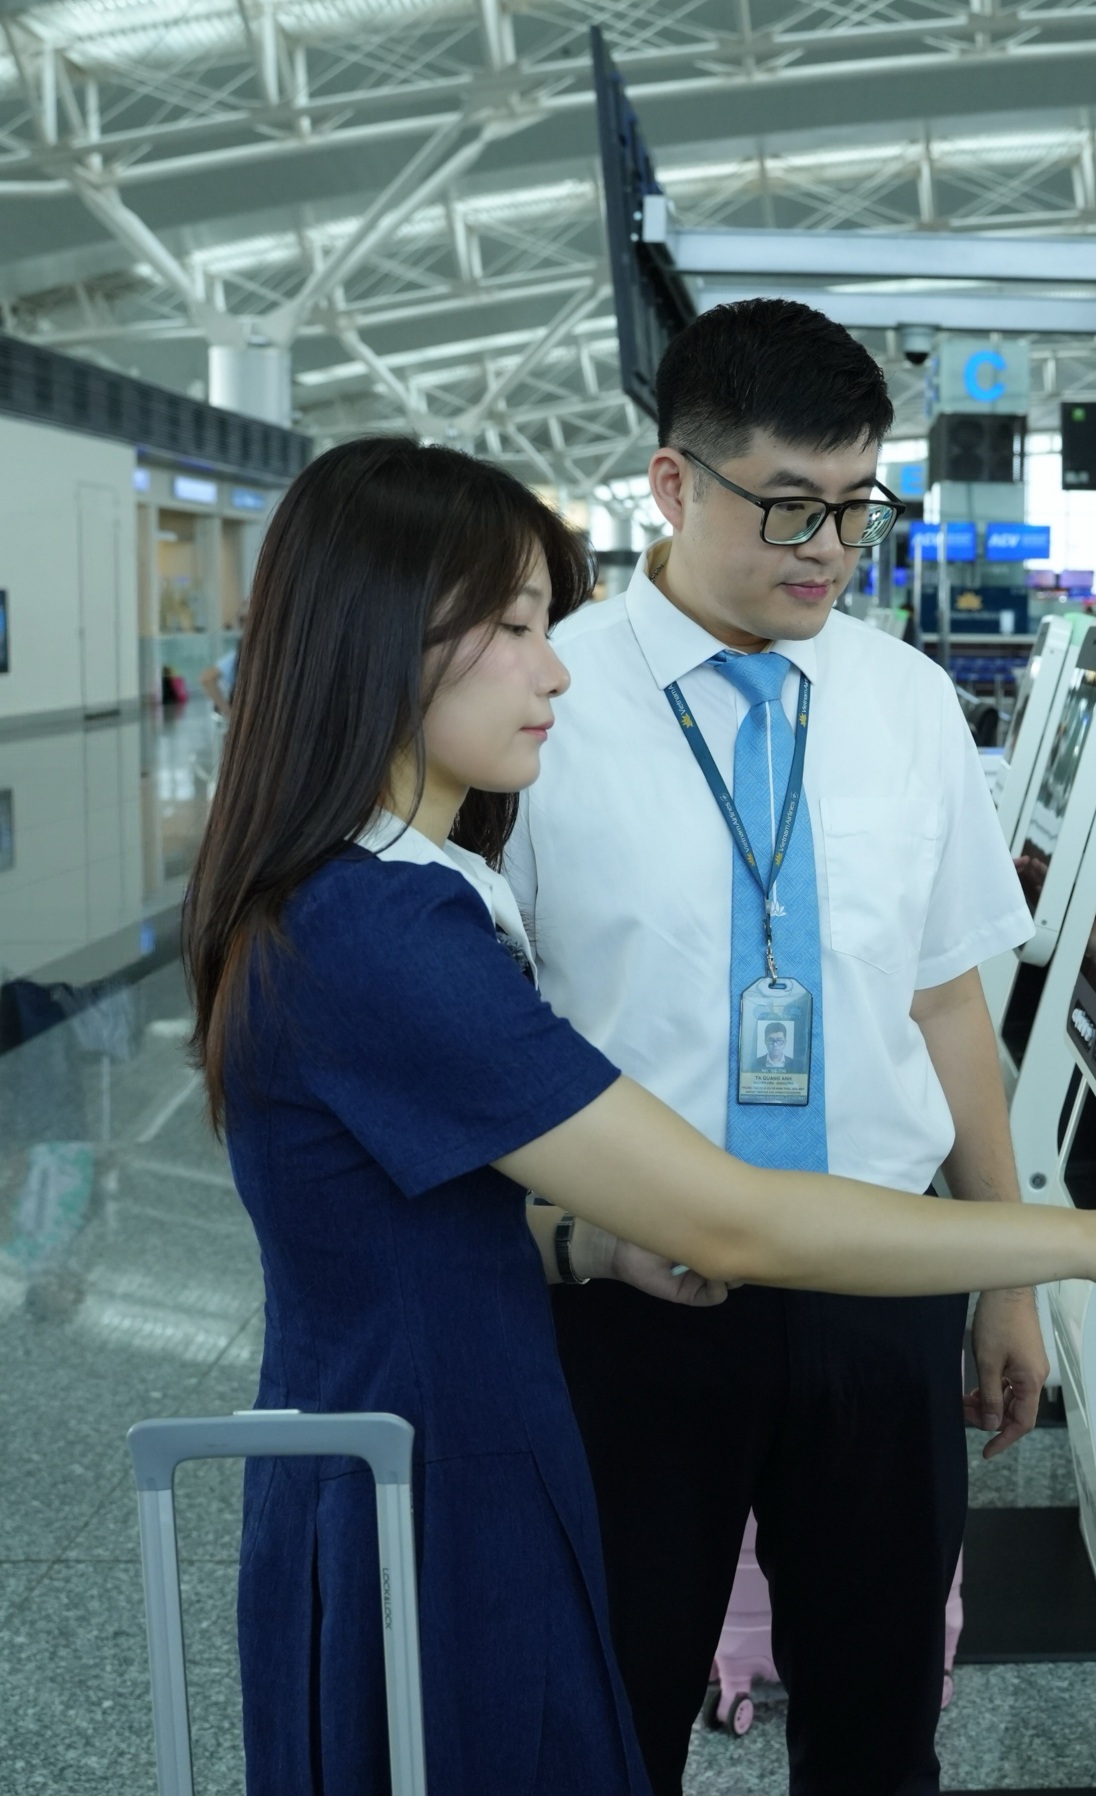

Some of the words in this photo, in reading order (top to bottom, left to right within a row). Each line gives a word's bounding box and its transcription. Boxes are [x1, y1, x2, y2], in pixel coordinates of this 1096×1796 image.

[963, 350, 1006, 402] C
[900, 466, 924, 494] E
[382, 1567, 392, 1631] LOCK&LOCK
